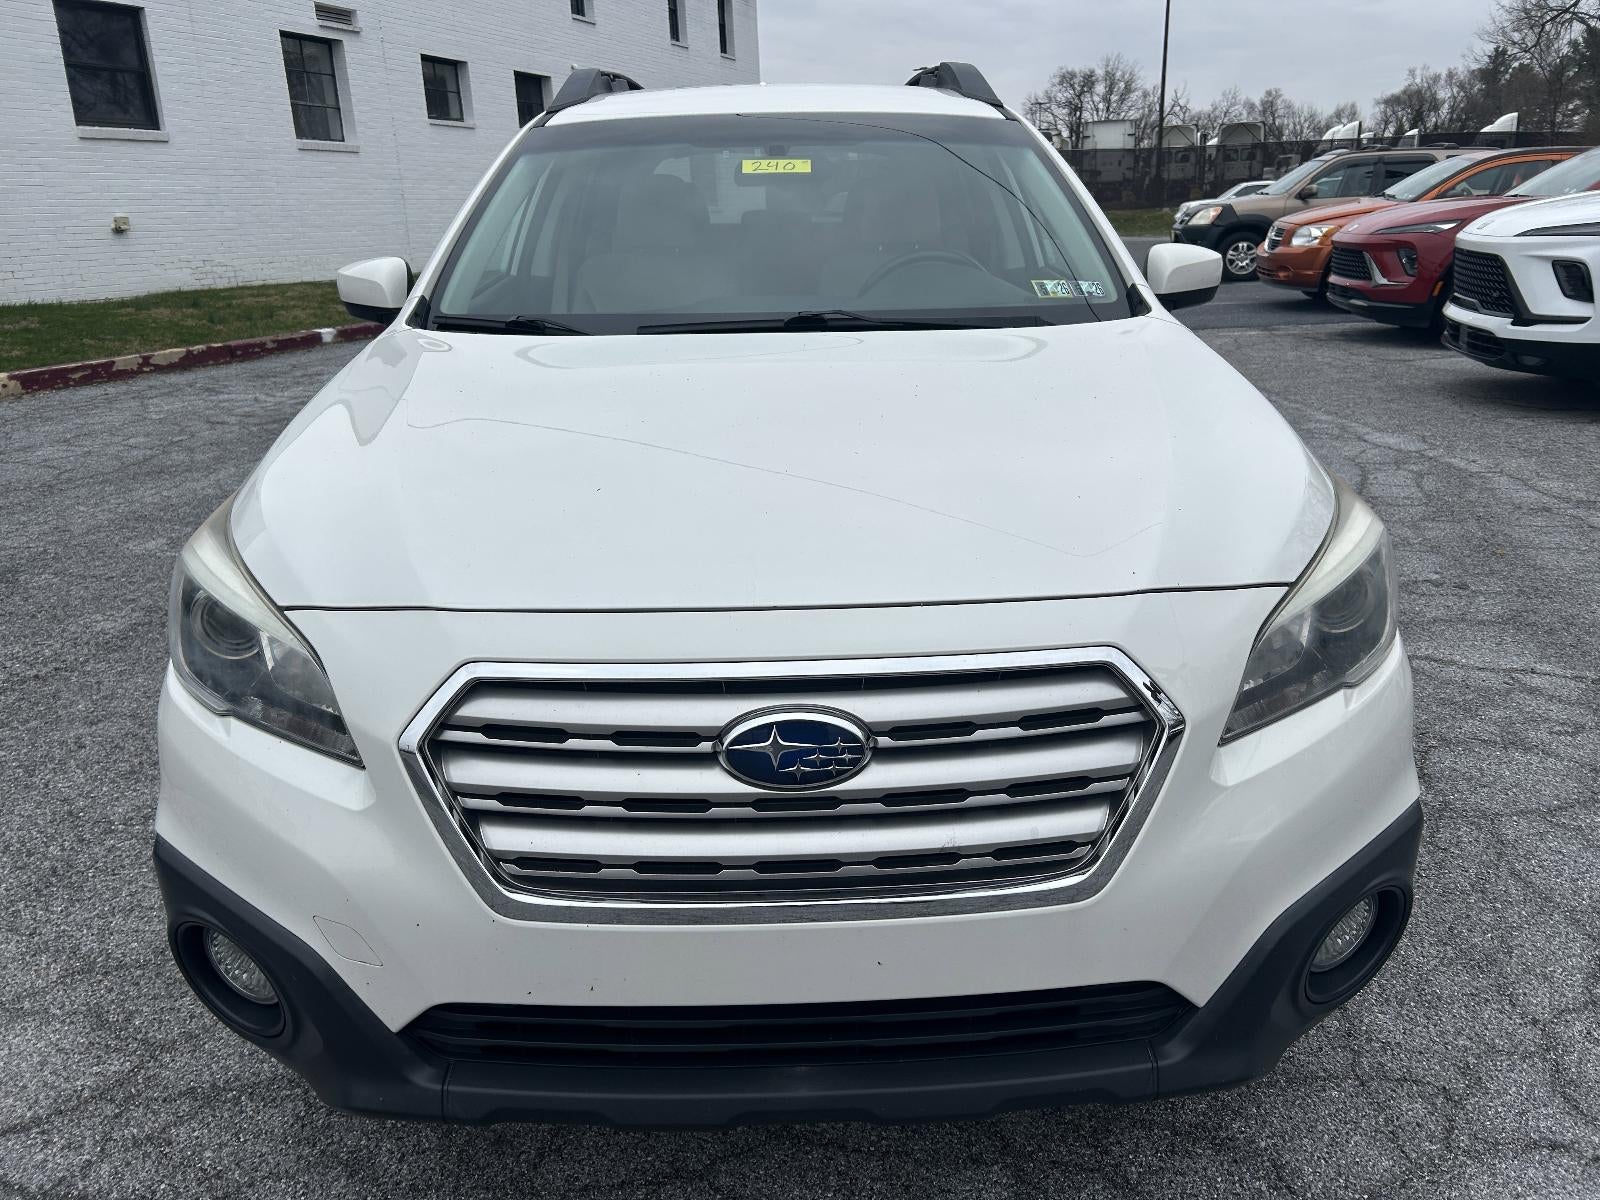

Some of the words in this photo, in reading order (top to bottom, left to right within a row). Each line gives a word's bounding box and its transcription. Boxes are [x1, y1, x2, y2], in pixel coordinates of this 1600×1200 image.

[752, 161, 796, 171] 240
[1058, 282, 1070, 295] 26
[1092, 282, 1105, 295] 26
